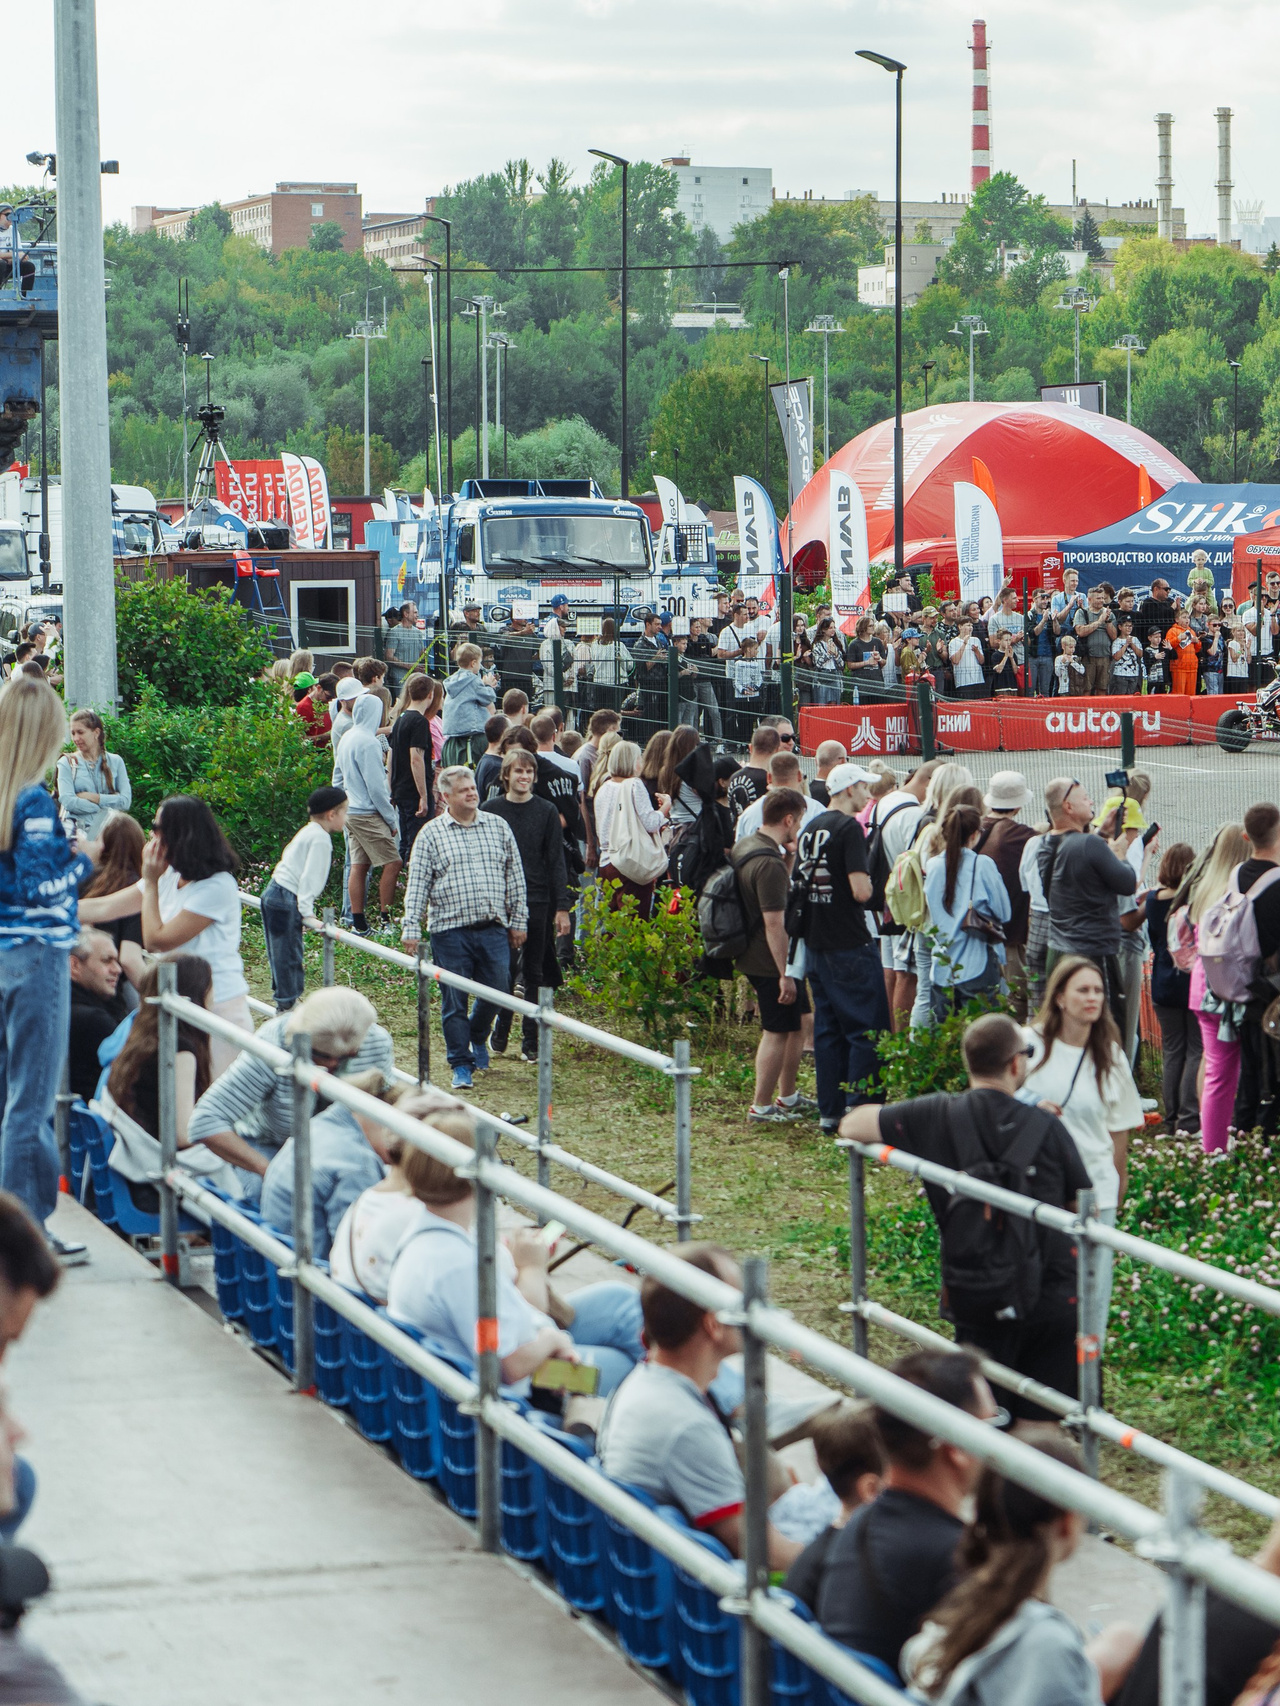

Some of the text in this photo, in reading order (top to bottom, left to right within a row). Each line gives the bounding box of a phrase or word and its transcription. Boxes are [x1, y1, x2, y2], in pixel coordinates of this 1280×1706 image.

[1171, 534, 1234, 543] Forged Whe
[1063, 552, 1235, 565] ПРОИЗВОДСТВО КОВАНХ ДИ
[1045, 708, 1160, 733] autou
